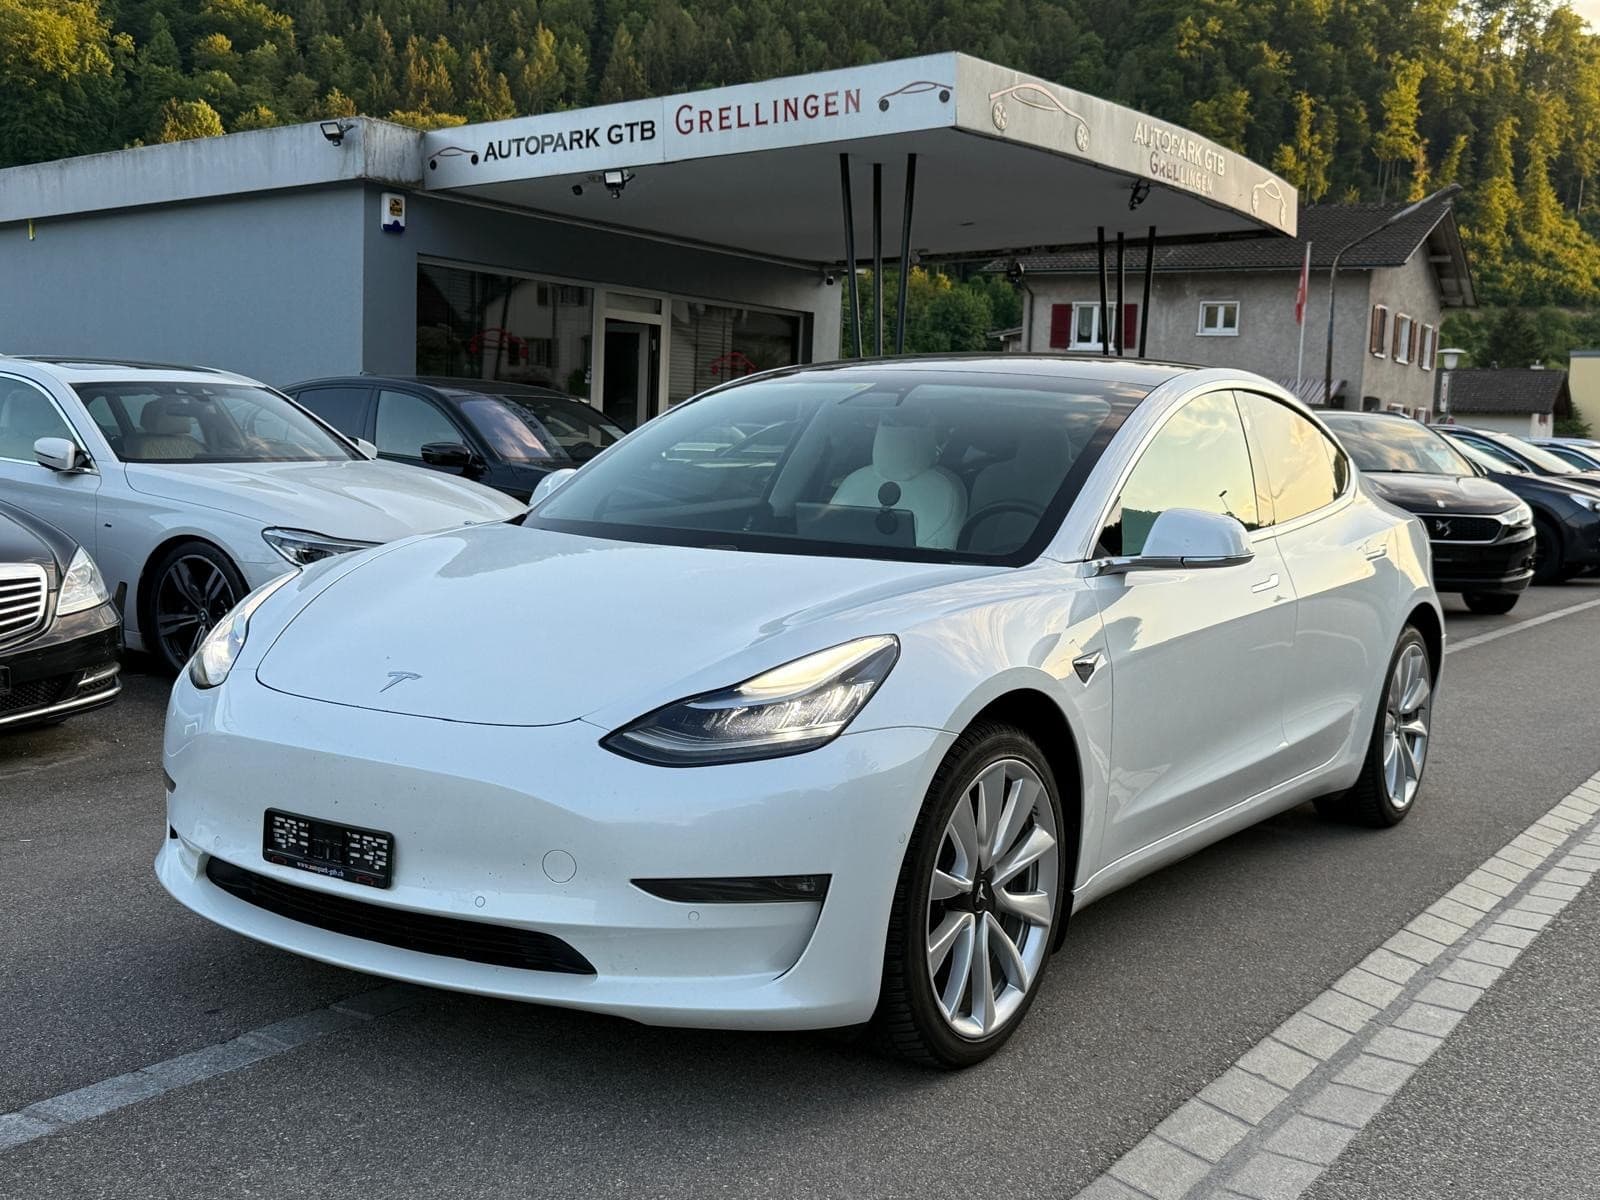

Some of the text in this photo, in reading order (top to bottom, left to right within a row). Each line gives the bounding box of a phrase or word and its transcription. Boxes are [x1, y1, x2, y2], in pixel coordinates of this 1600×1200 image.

[675, 88, 861, 135] GRELLINGEN
[483, 119, 656, 162] AUTOPARK GTB
[1133, 121, 1225, 176] AUTOPARK GTB
